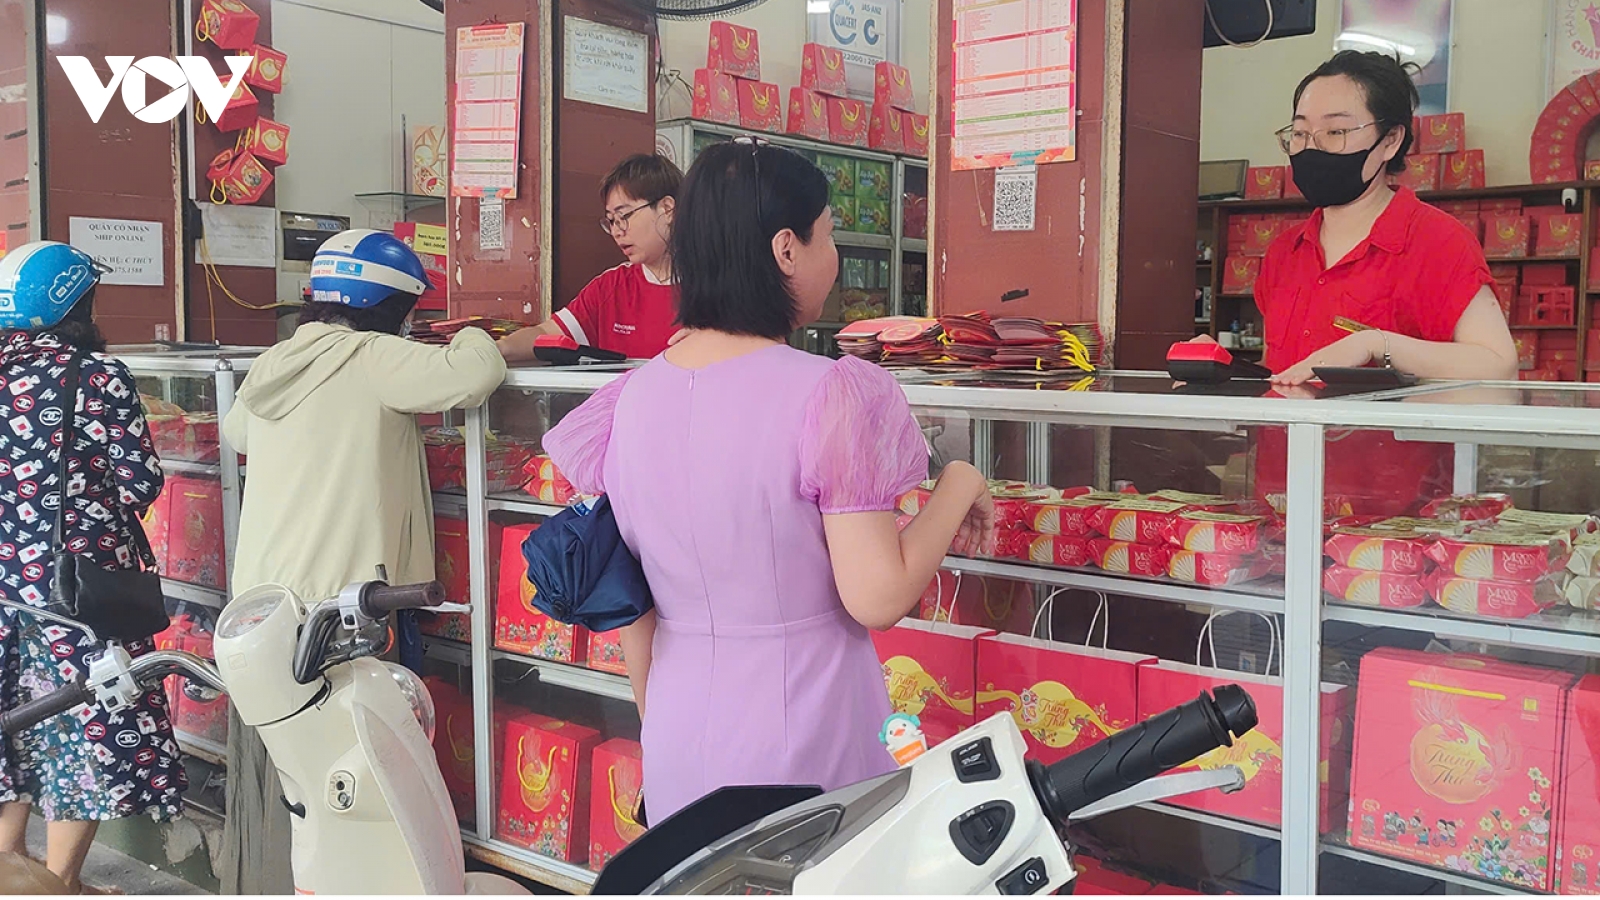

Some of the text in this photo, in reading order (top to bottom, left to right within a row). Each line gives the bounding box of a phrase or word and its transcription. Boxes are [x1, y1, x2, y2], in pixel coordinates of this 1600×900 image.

[114, 234, 145, 242] ONLINE
[94, 255, 107, 263] IÊN
[1039, 698, 1070, 719] Trung
[1045, 713, 1067, 728] Thu
[1424, 744, 1476, 776] Trung
[1430, 764, 1465, 786] Thu
